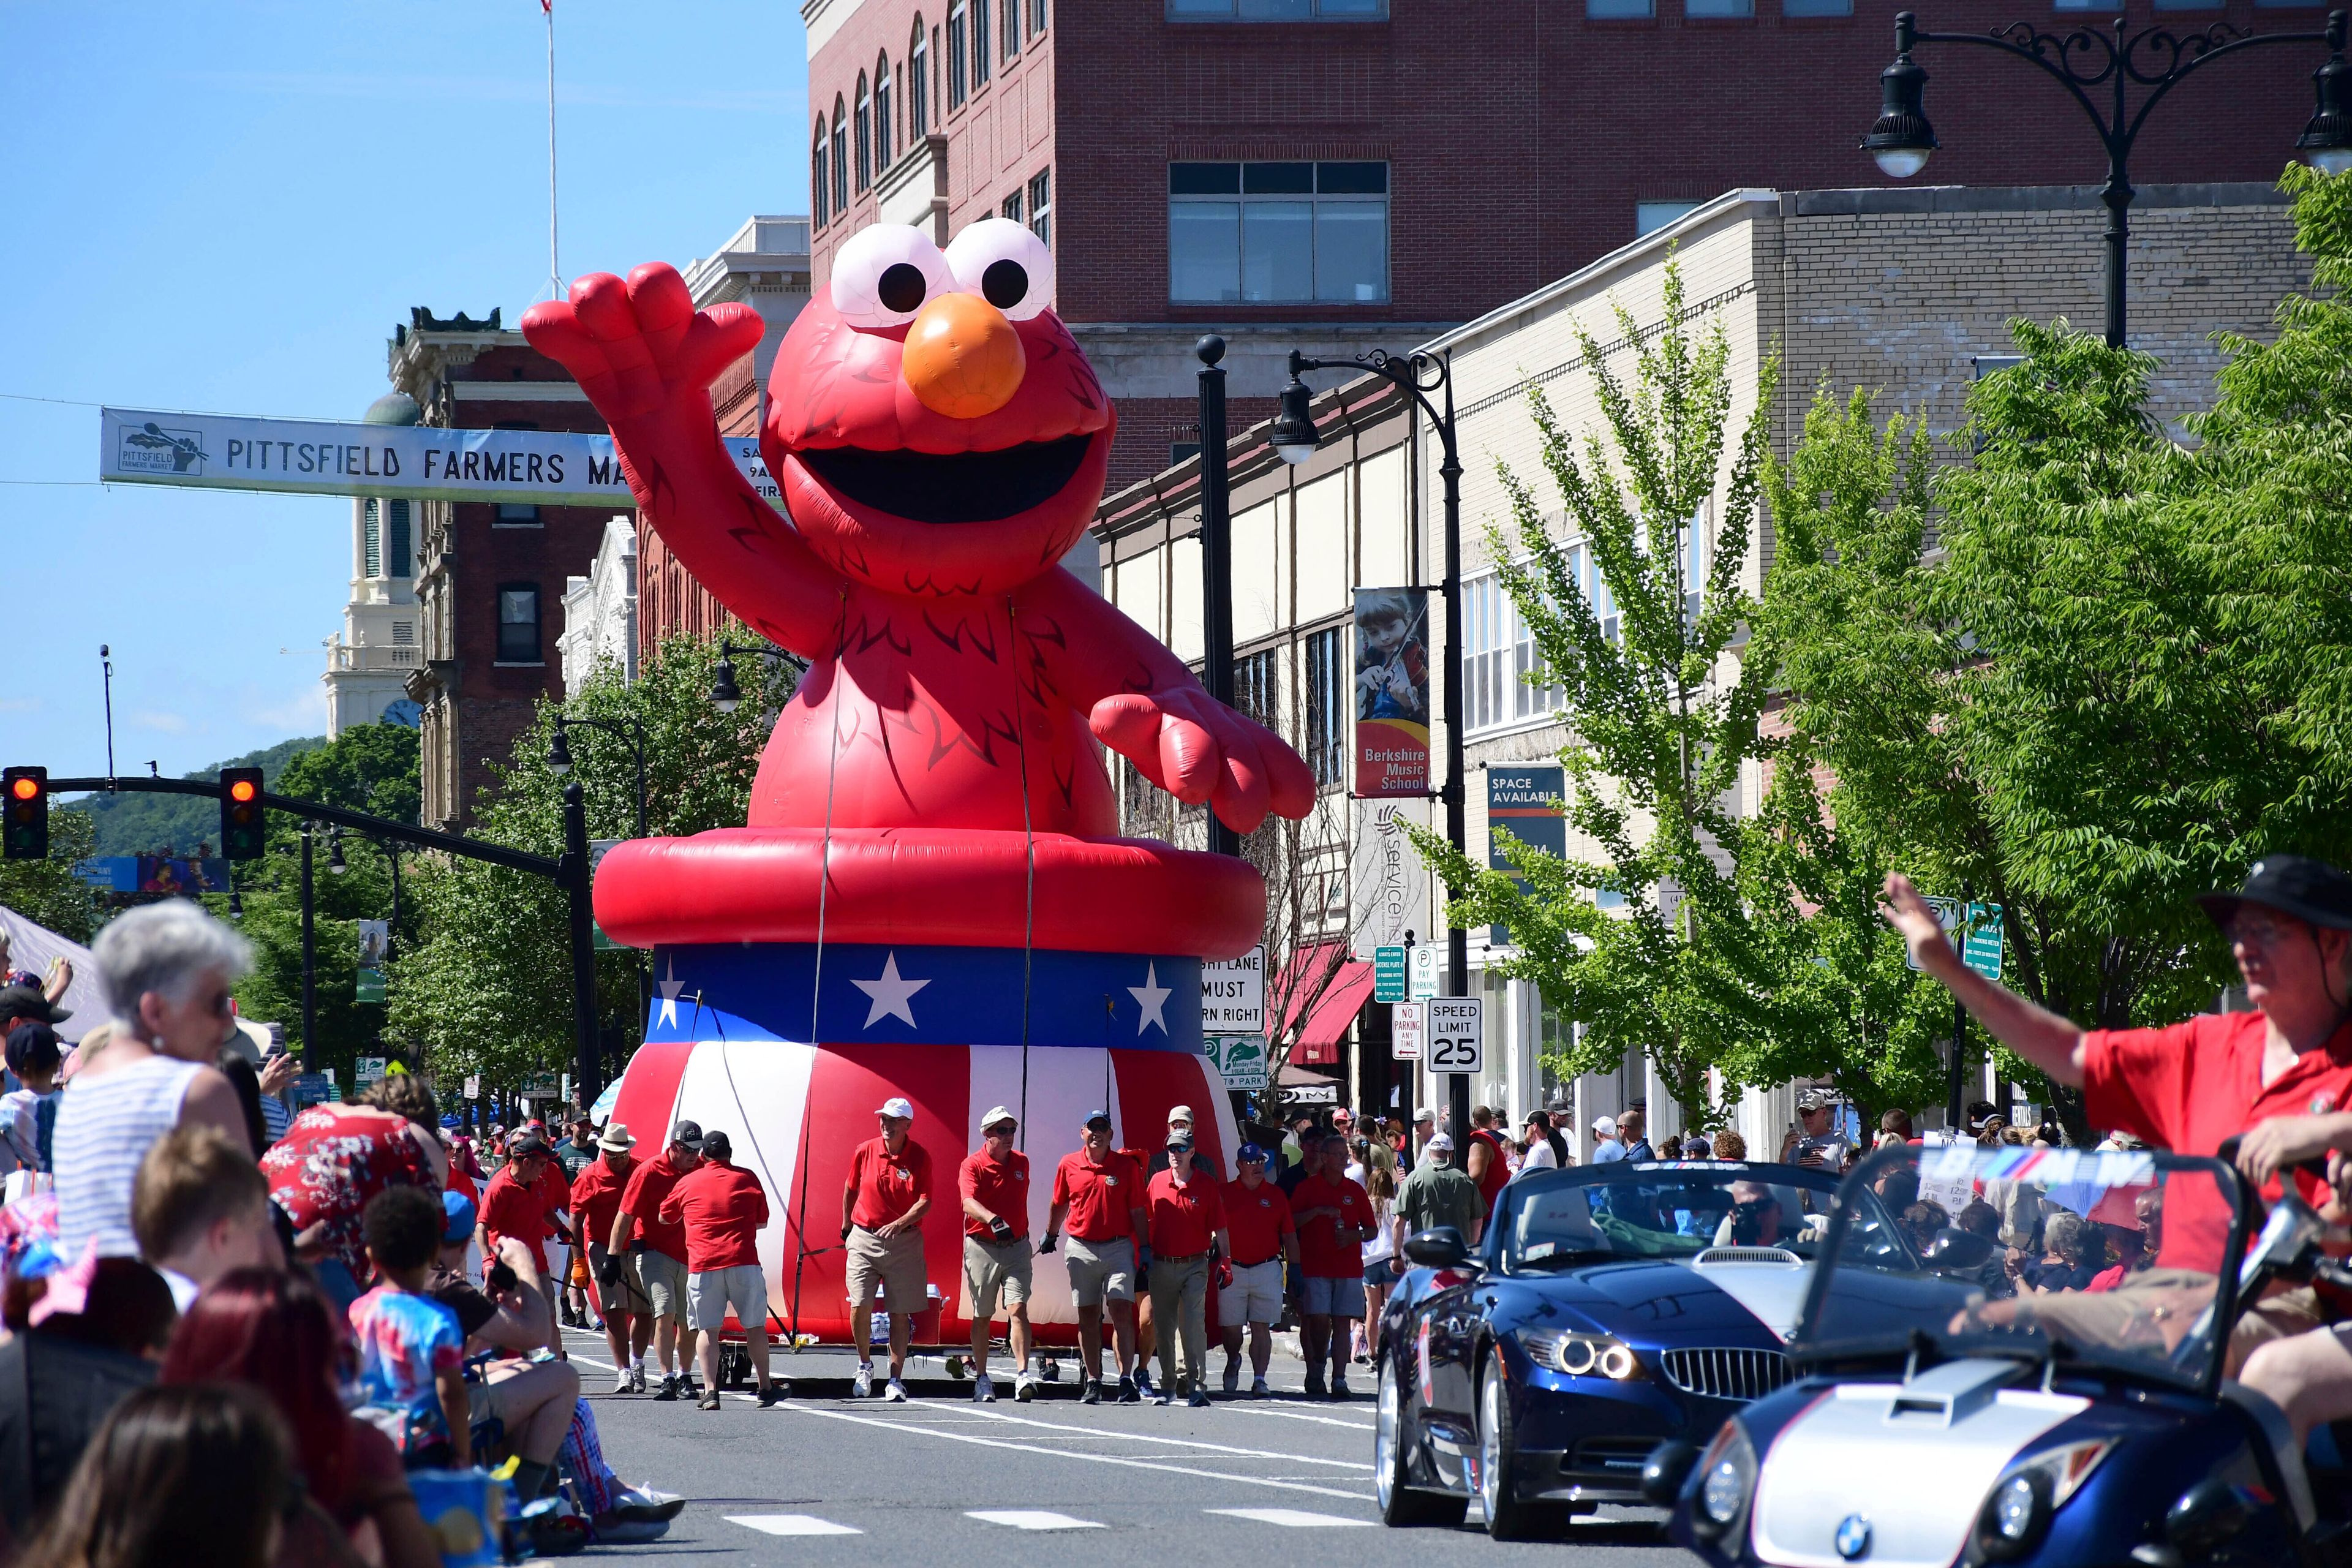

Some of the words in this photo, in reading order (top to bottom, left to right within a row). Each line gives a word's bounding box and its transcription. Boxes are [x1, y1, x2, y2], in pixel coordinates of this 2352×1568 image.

[123, 451, 172, 462] PITTSFIELD
[227, 439, 400, 477] PITTSFIELD
[424, 449, 564, 484] FARMERS
[749, 466, 772, 477] 9A
[755, 486, 781, 497] FIR
[1365, 748, 1425, 761] Berkshire
[1387, 762, 1424, 775] Music
[1381, 776, 1423, 790] School
[1492, 778, 1532, 789] SPACE
[1493, 791, 1558, 803] AVAILABLE
[1227, 957, 1259, 970] LANE
[1419, 970, 1430, 979] PAY
[1202, 981, 1245, 998] MUST
[1412, 981, 1437, 990] PARKING
[1224, 1008, 1260, 1021] RIGHT
[1401, 1008, 1413, 1019] NO
[1433, 1006, 1477, 1017] SPEED
[1395, 1020, 1420, 1031] PARKING
[1438, 1022, 1471, 1033] LIMIT
[1433, 1038, 1477, 1065] 25
[1238, 1077, 1262, 1085] PARK
[2011, 1105, 2032, 1127] RENTALS
